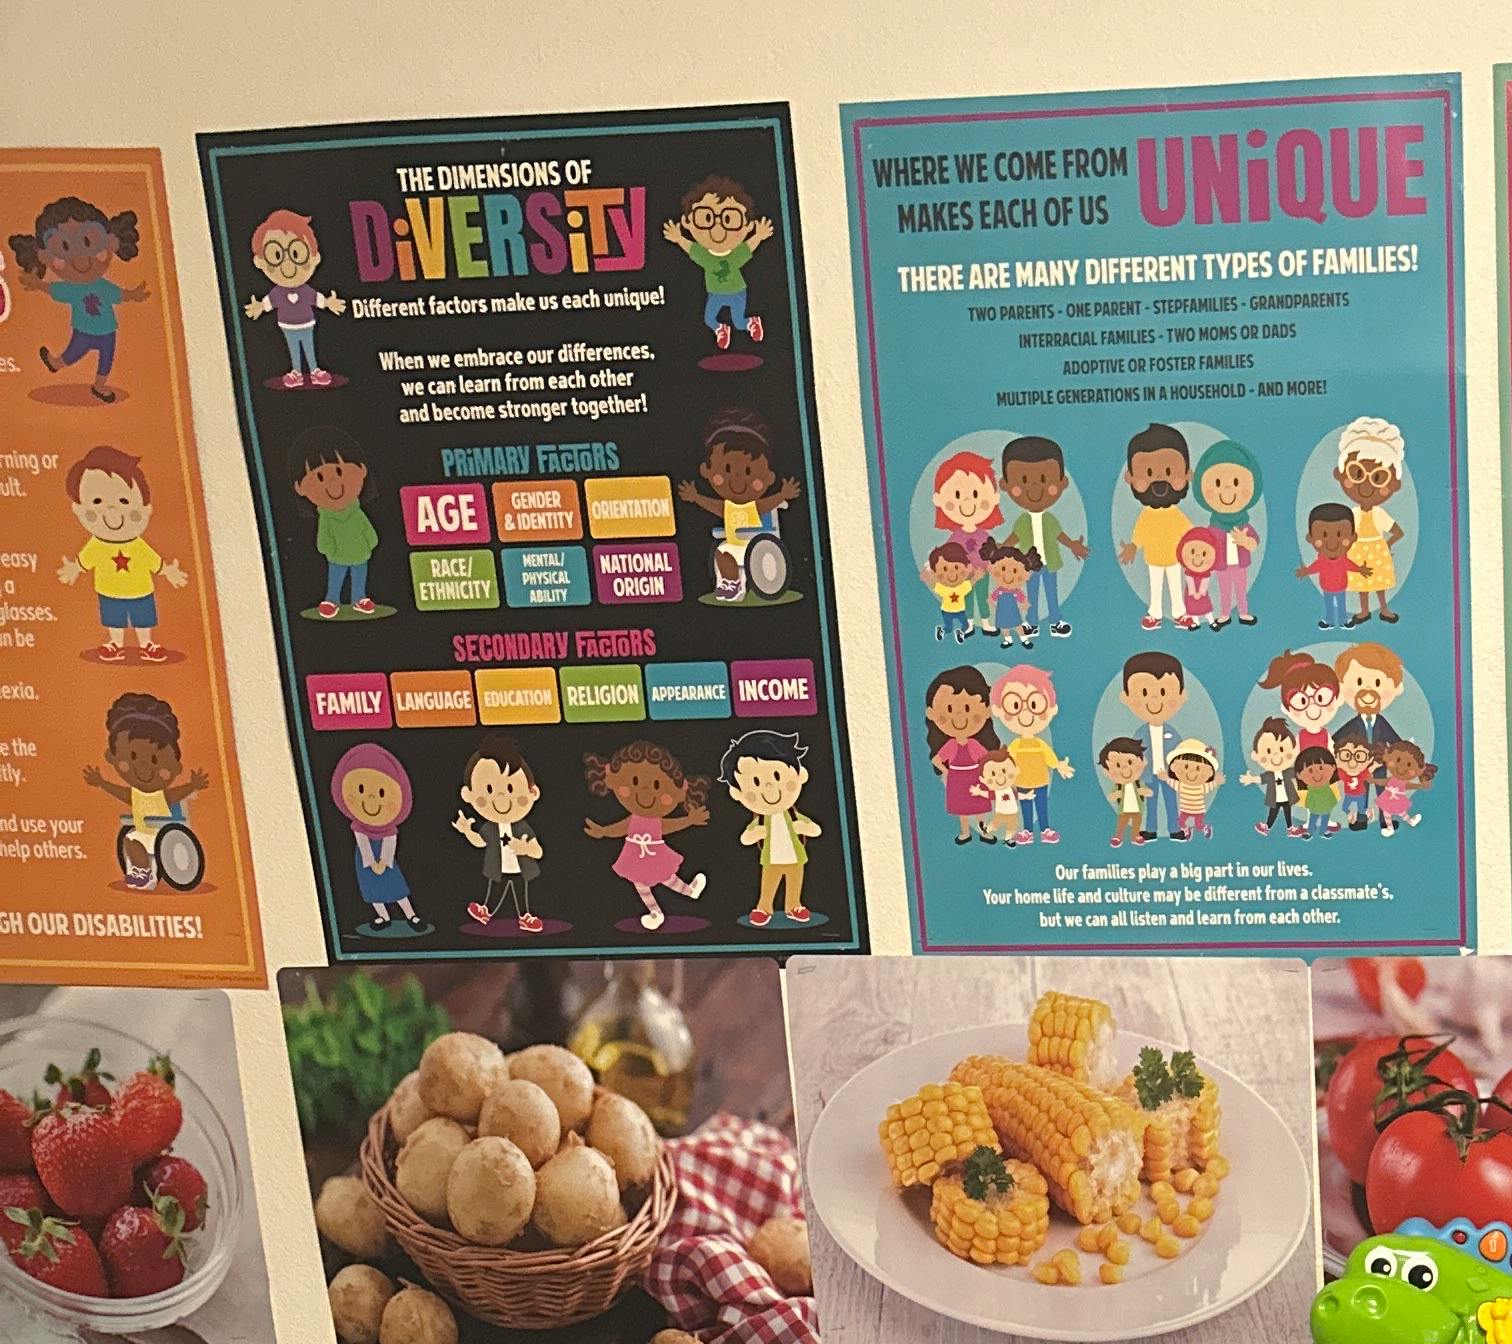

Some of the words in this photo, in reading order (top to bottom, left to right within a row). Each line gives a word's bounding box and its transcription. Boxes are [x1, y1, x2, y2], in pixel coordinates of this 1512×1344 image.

[397, 167, 434, 192] THE
[438, 161, 561, 190] DIMENSIONS
[565, 159, 592, 185] OF
[872, 155, 949, 188] WHERE
[954, 153, 988, 183] WE
[994, 150, 1057, 181] COME
[1063, 147, 1127, 178] FROM
[897, 201, 974, 233] MAKES
[979, 198, 1037, 230] EACH
[1044, 197, 1073, 226] OF
[1079, 195, 1109, 225] US
[898, 264, 964, 292] THERE
[969, 262, 1011, 289] ARE
[1015, 260, 1078, 287] MANY
[1085, 255, 1197, 284] DIFFERENT
[1203, 251, 1273, 280] TYPES
[1277, 249, 1308, 278] OF
[1311, 245, 1418, 275] FAMILIES!
[352, 298, 426, 318] Different
[428, 295, 488, 315] factors
[491, 292, 535, 312] make
[539, 295, 558, 310] us
[562, 289, 600, 309] each
[604, 285, 665, 311] unique!
[1063, 359, 1125, 375] ADOPTIVE
[1128, 358, 1146, 373] OR
[1149, 356, 1196, 372] FOSTER
[1199, 354, 1254, 370] FAMILIES
[511, 491, 561, 511] GENDER
[592, 498, 670, 519] ORIENTATION
[416, 494, 478, 533] AGE
[504, 514, 516, 531] &
[517, 511, 573, 531] IDENTITY
[430, 558, 473, 578] RACE/
[523, 552, 565, 568] MENTAL/
[600, 552, 673, 574] NATIONAL
[522, 570, 571, 586] PHYSICAL
[613, 575, 665, 597] ORIGIN
[420, 580, 491, 602] ETHNICITY
[529, 587, 568, 603] ABILITY
[453, 632, 568, 662] SECONDARY
[396, 691, 472, 711] LANGUAGE
[484, 690, 552, 708] EDUCATION
[567, 684, 639, 706] RELIGION
[651, 684, 727, 702] APPEARANCE
[739, 678, 809, 702] INCOME
[315, 689, 383, 718] FAMILY
[1055, 864, 1079, 880] Our
[1082, 864, 1136, 880] families
[1138, 863, 1166, 883] play
[1170, 867, 1178, 879] a
[1180, 862, 1202, 882] big
[1205, 862, 1234, 882] part
[1236, 862, 1250, 877] in
[1252, 865, 1274, 877] our
[1277, 861, 1313, 877] lives.
[28, 913, 69, 935] OUR
[73, 914, 202, 938] DISABILITIES!
